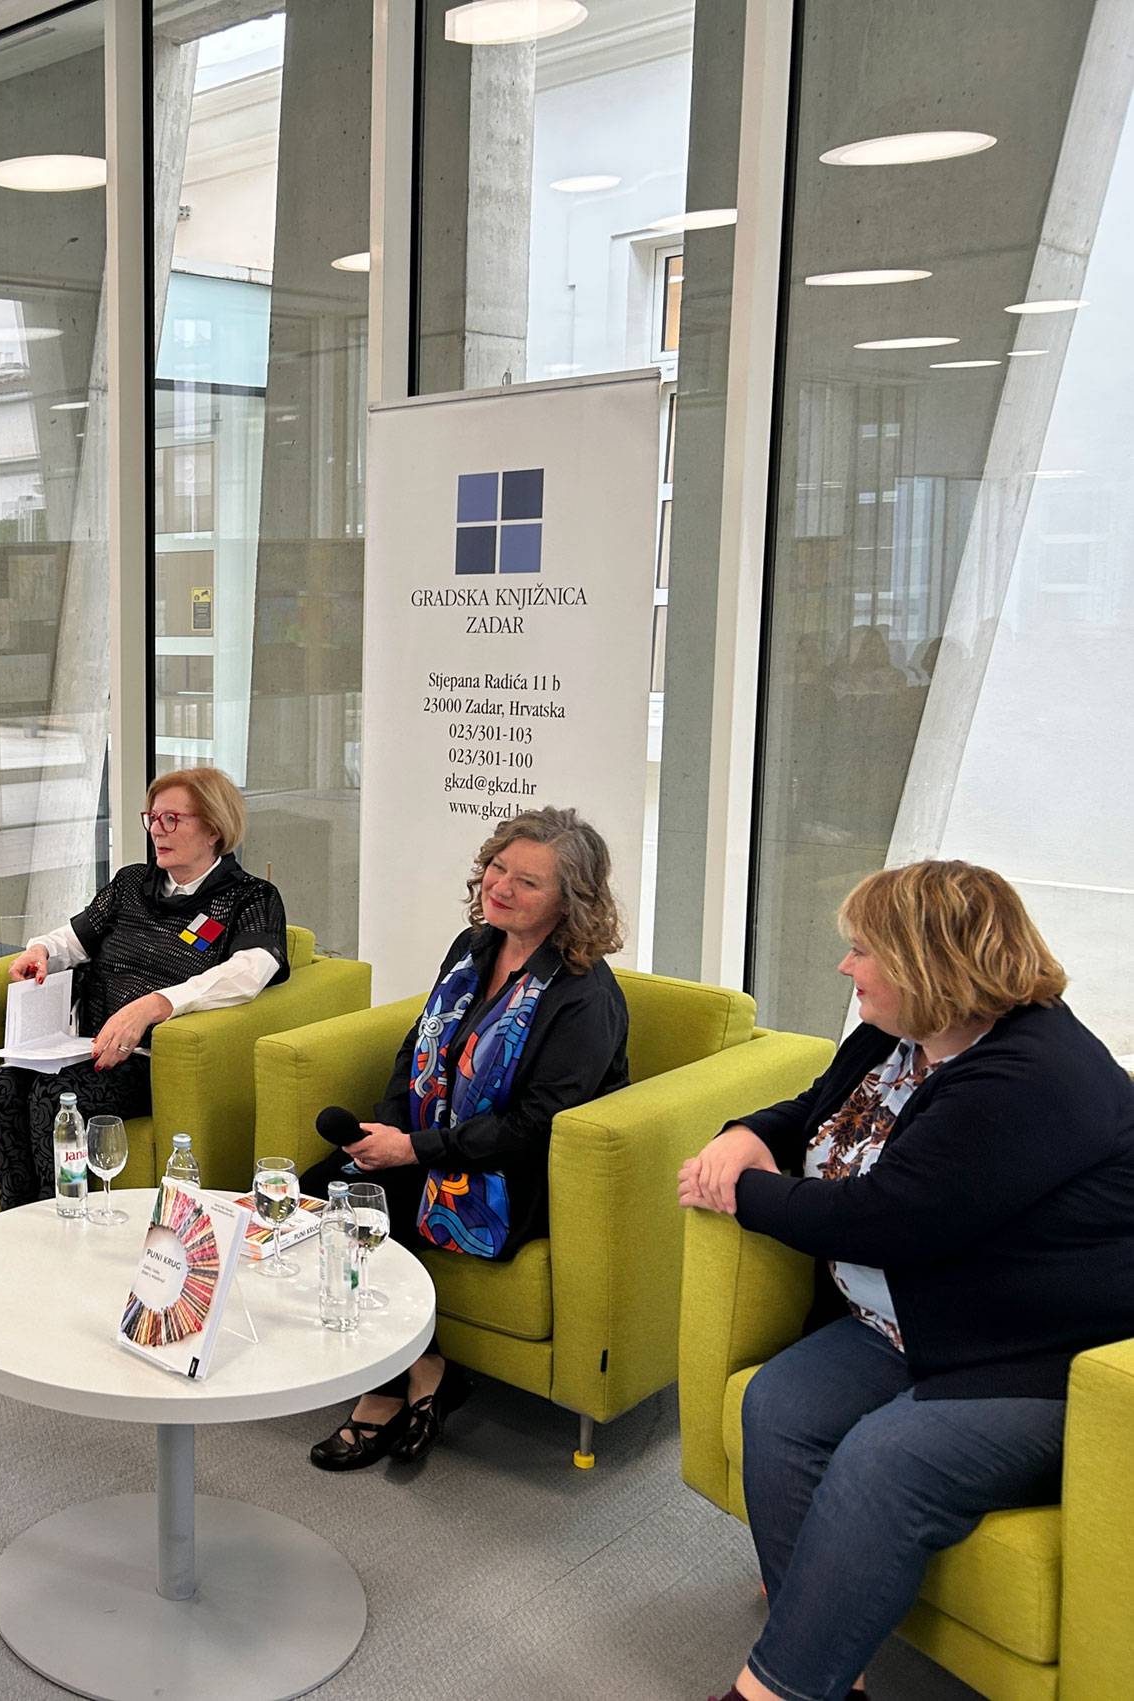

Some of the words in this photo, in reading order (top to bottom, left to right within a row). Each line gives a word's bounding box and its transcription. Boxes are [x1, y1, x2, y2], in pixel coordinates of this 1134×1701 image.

[411, 588, 490, 607] GRADSKA
[495, 583, 588, 610] KNJIŽNICA
[466, 616, 525, 634] ZADAR
[428, 672, 480, 692] Stjepana
[484, 673, 528, 690] Radića
[533, 675, 547, 691] 11
[552, 675, 561, 692] b
[423, 697, 462, 714] 23000
[465, 698, 505, 718] Zadar,
[509, 700, 566, 719] Hrvatska
[449, 723, 533, 745] 023/301-103
[448, 748, 534, 768] 023/301-100
[444, 773, 537, 796] gkzd@gkzd.hr
[146, 1248, 162, 1262] PUNI
[163, 1255, 181, 1271] KRUG
